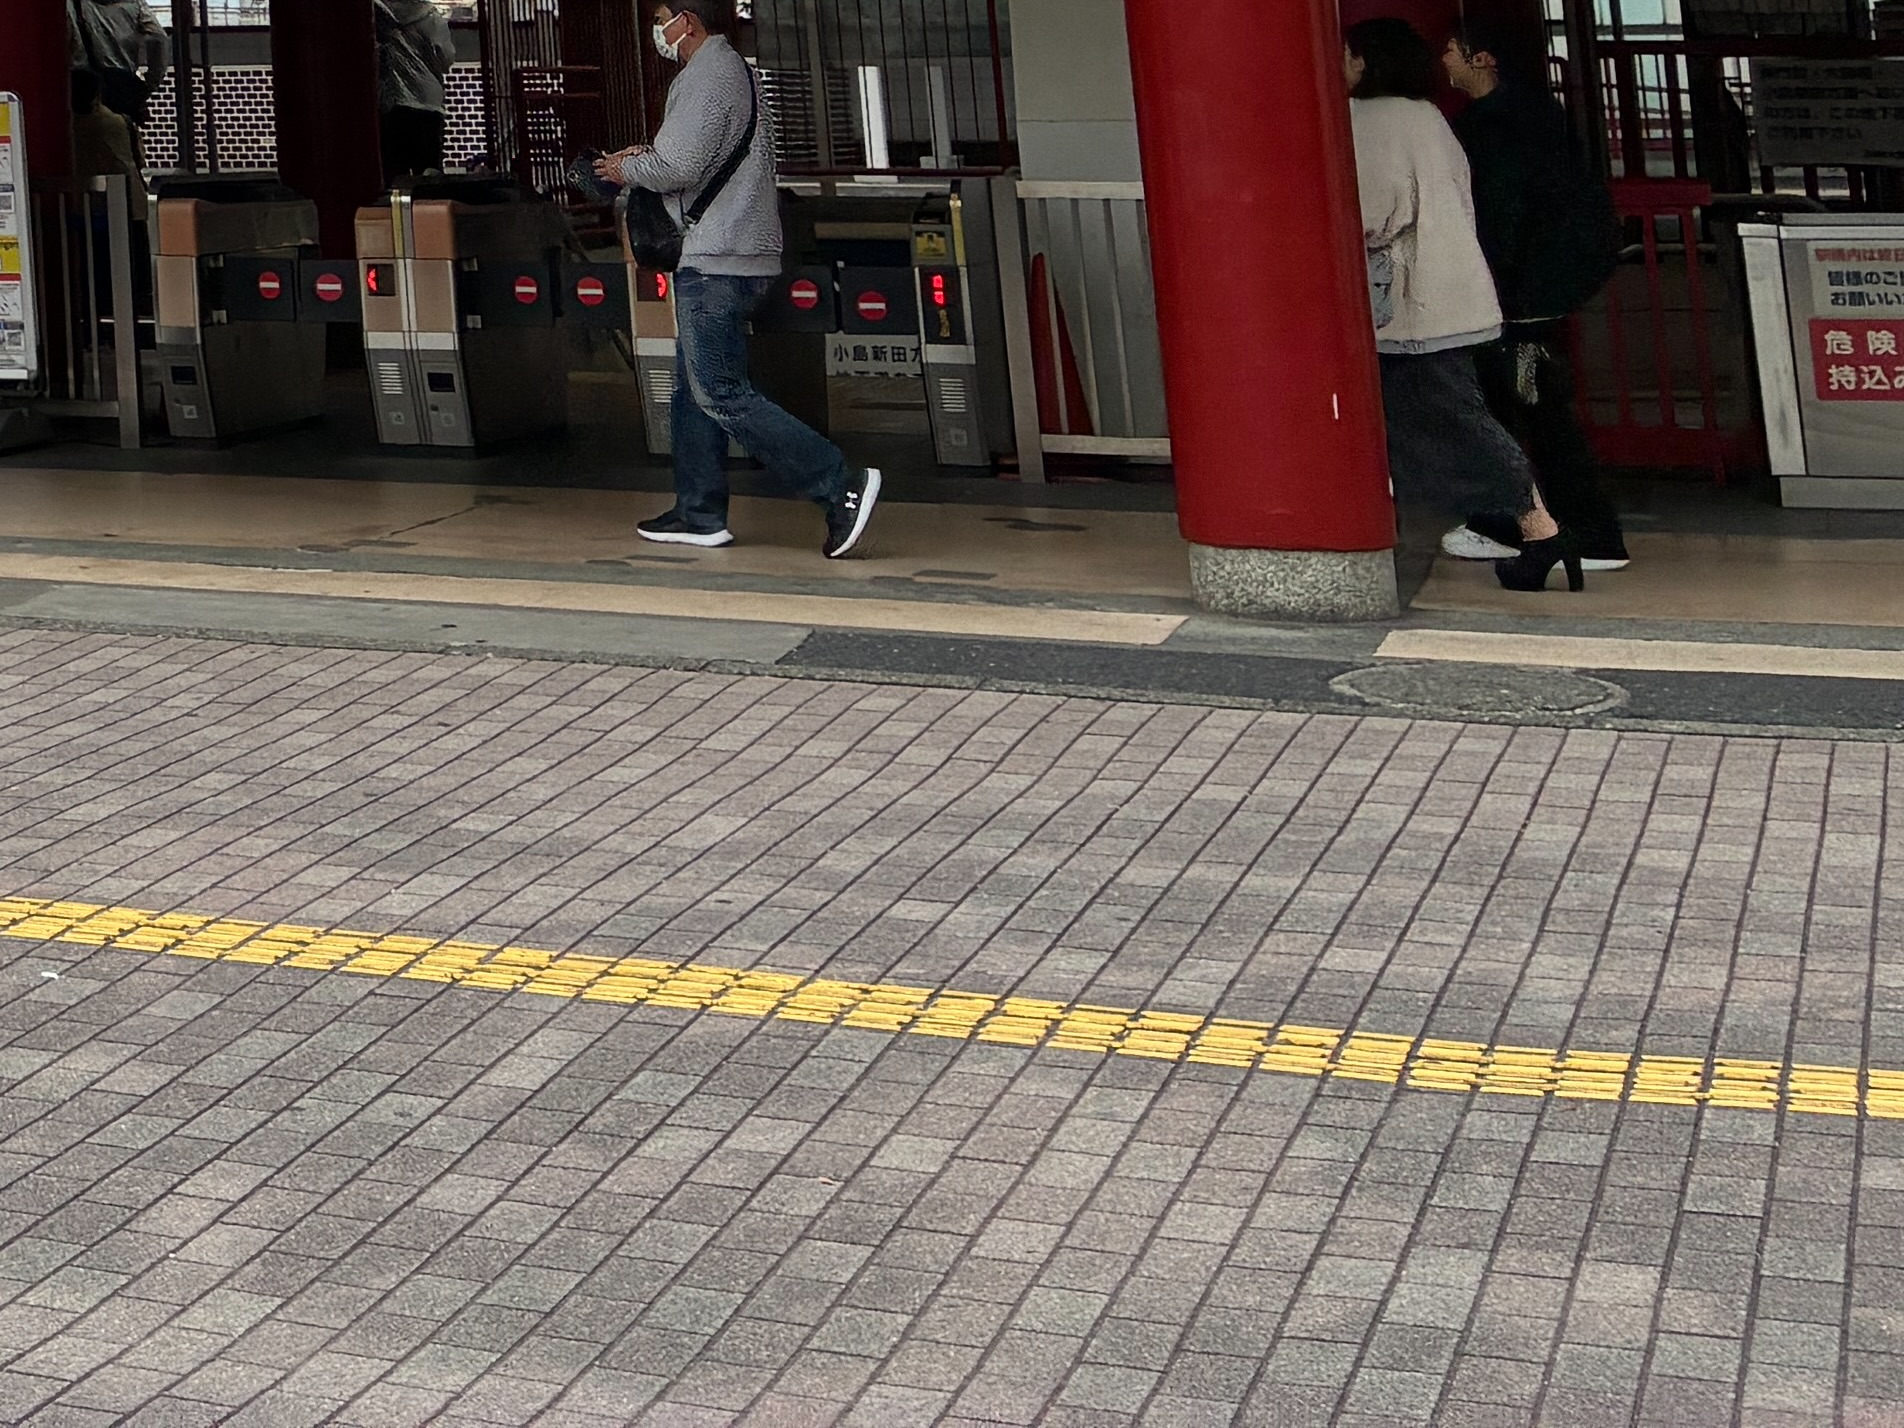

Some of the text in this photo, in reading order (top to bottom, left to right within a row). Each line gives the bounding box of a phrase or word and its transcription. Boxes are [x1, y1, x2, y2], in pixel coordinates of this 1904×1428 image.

[1830, 291, 1904, 306] お願いい
[1824, 330, 1898, 355] 危険
